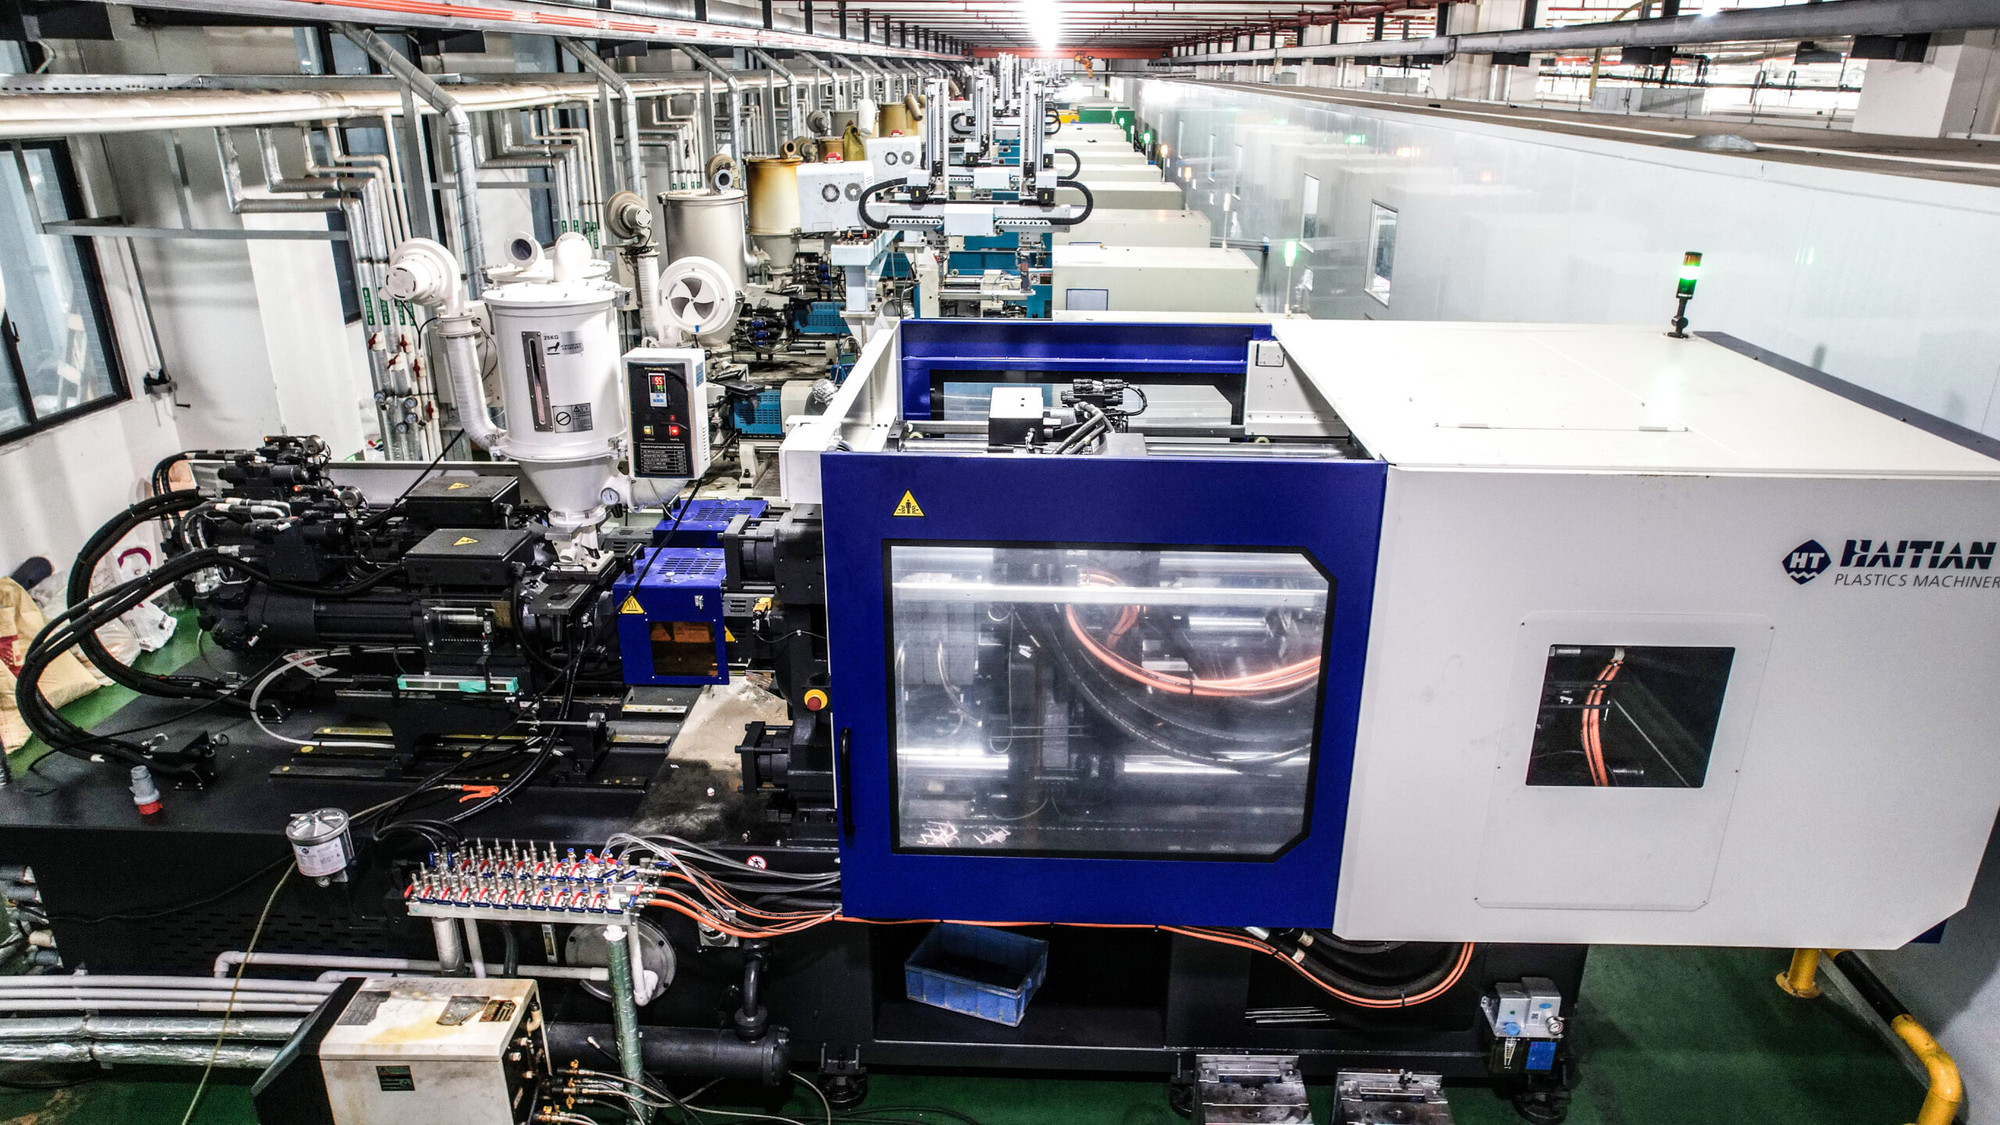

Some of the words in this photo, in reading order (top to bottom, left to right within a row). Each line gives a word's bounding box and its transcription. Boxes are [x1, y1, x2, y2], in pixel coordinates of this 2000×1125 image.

[1789, 552, 1826, 569] HT
[1840, 539, 1997, 570] HAITIAN
[1834, 573, 1908, 587] PLASTICS
